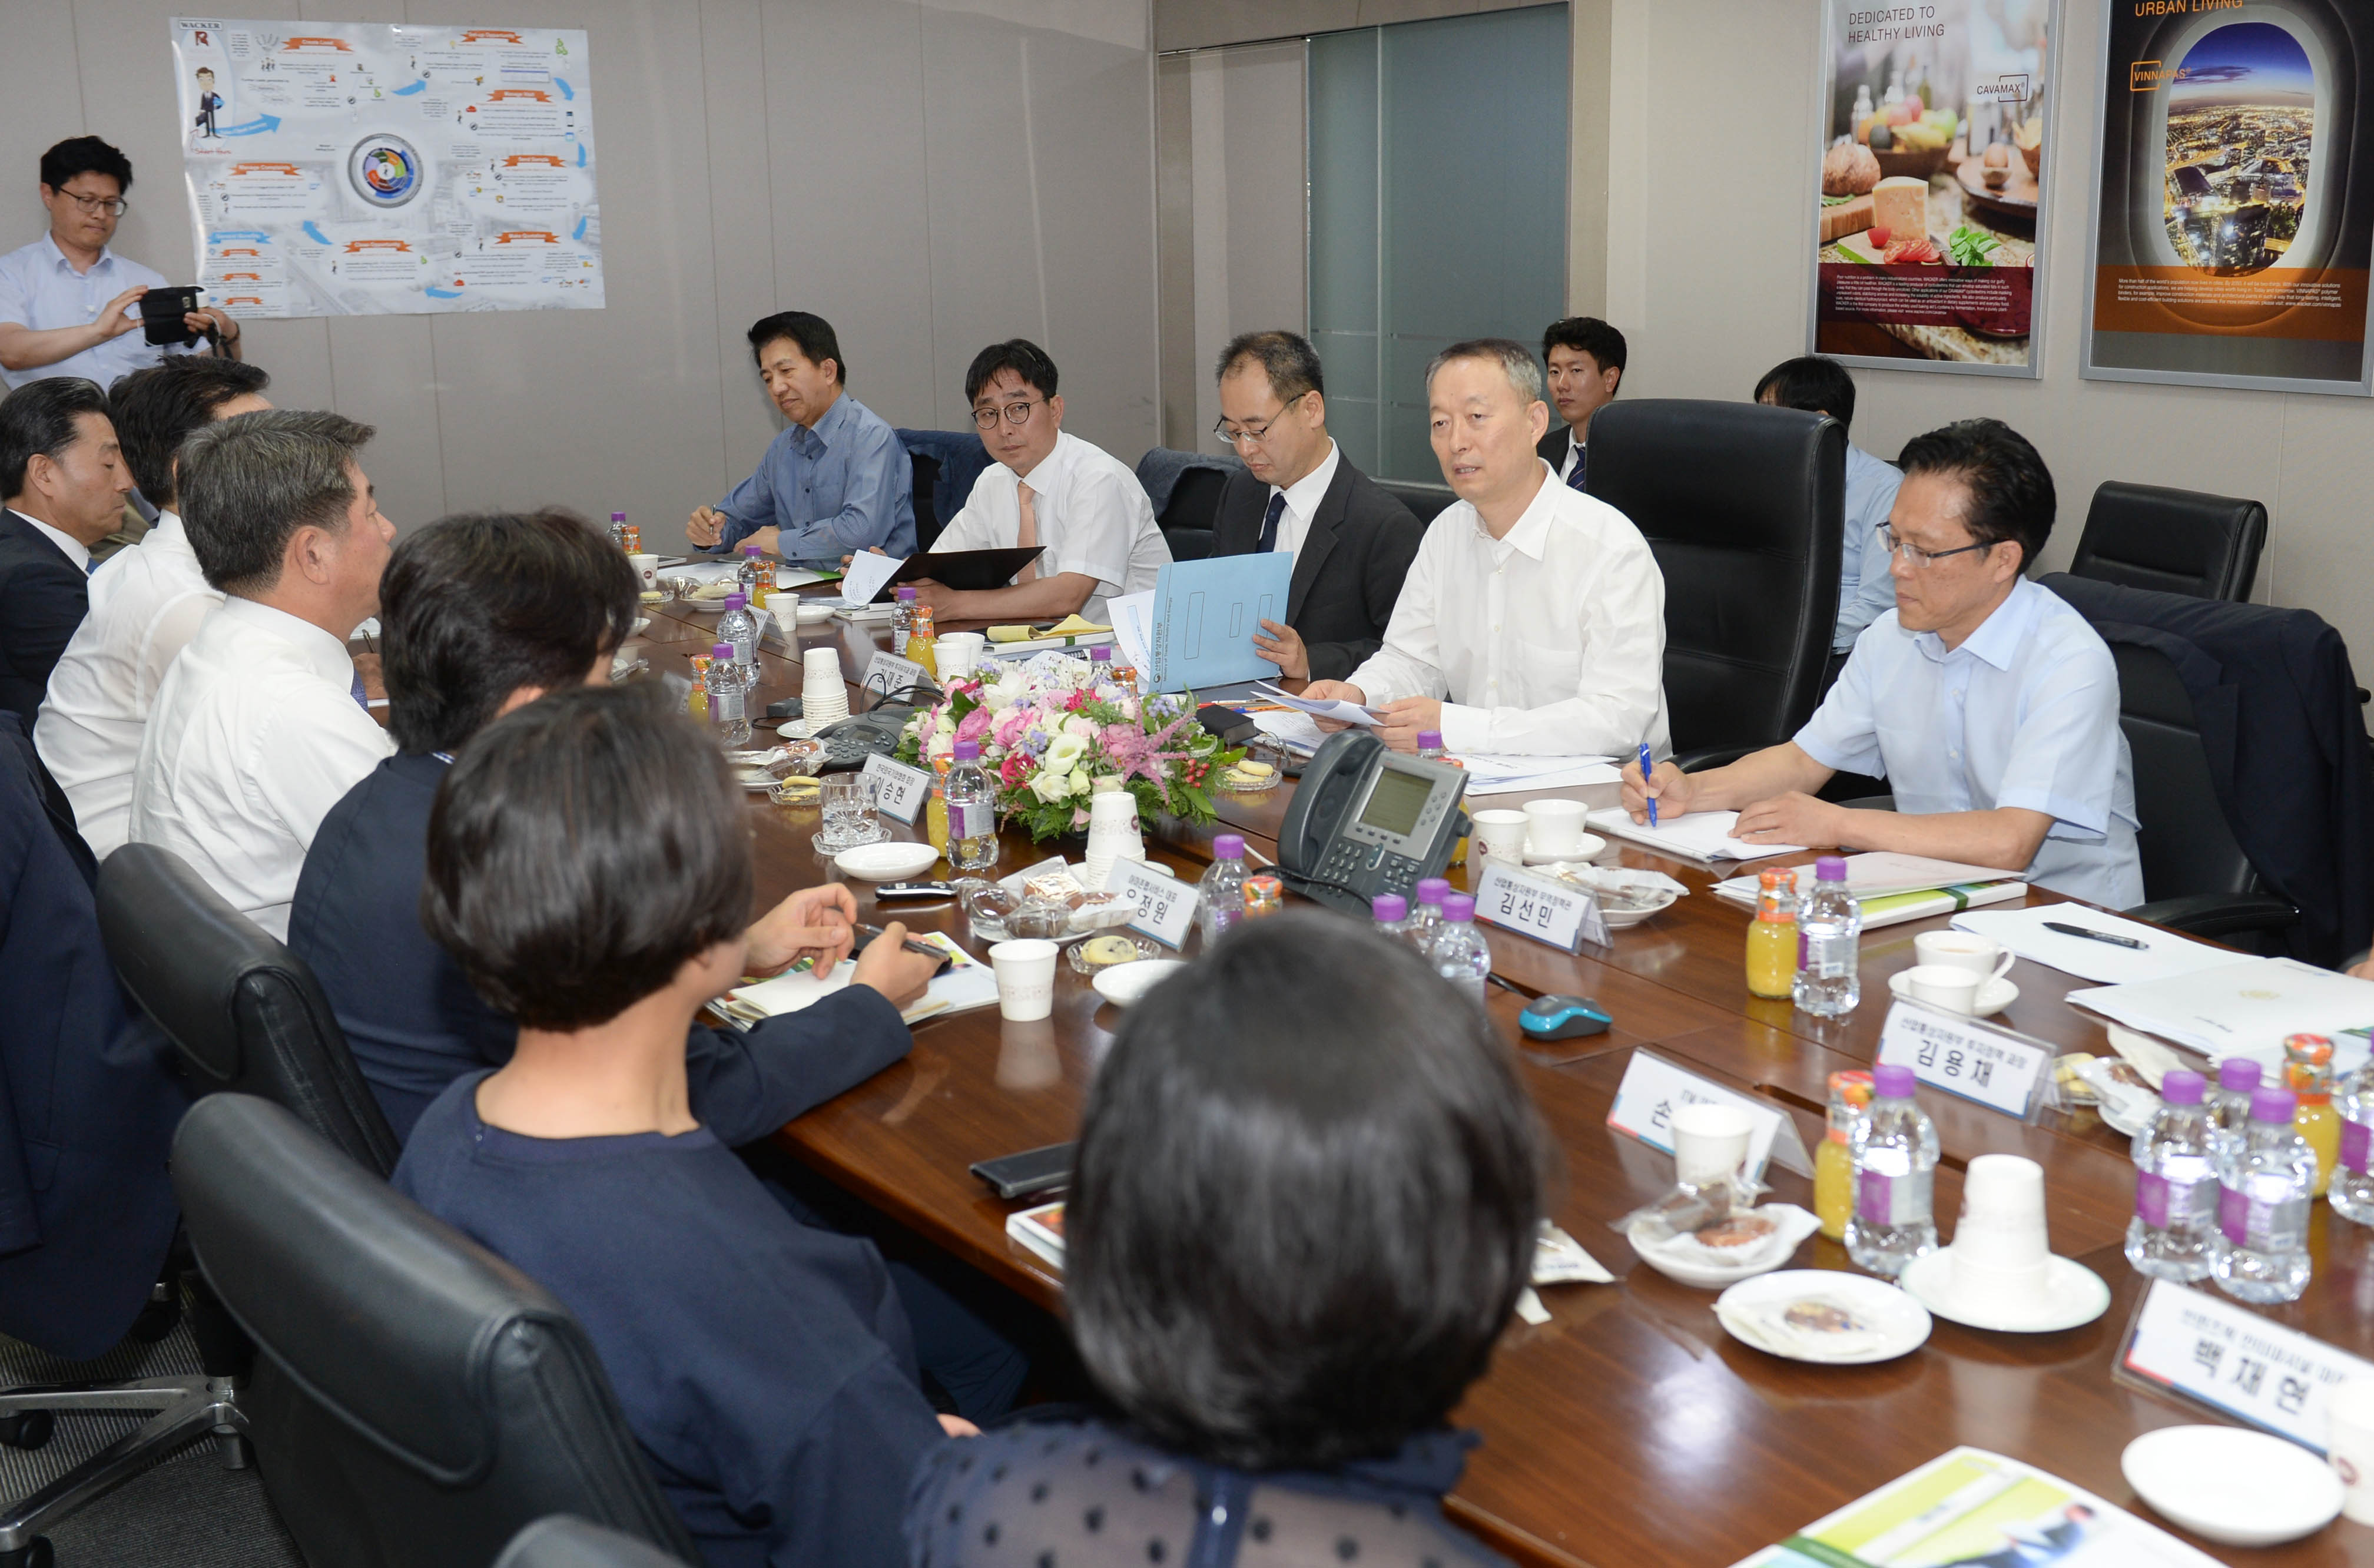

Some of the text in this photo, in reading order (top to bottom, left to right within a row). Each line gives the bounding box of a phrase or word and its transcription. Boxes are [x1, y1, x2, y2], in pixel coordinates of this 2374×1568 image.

[1849, 6, 1935, 25] DEDICATED TO
[2135, 0, 2243, 16] URBAN LIVING
[1848, 24, 1945, 42] HEALTHY LIVING
[1501, 893, 1553, 929] 김선민
